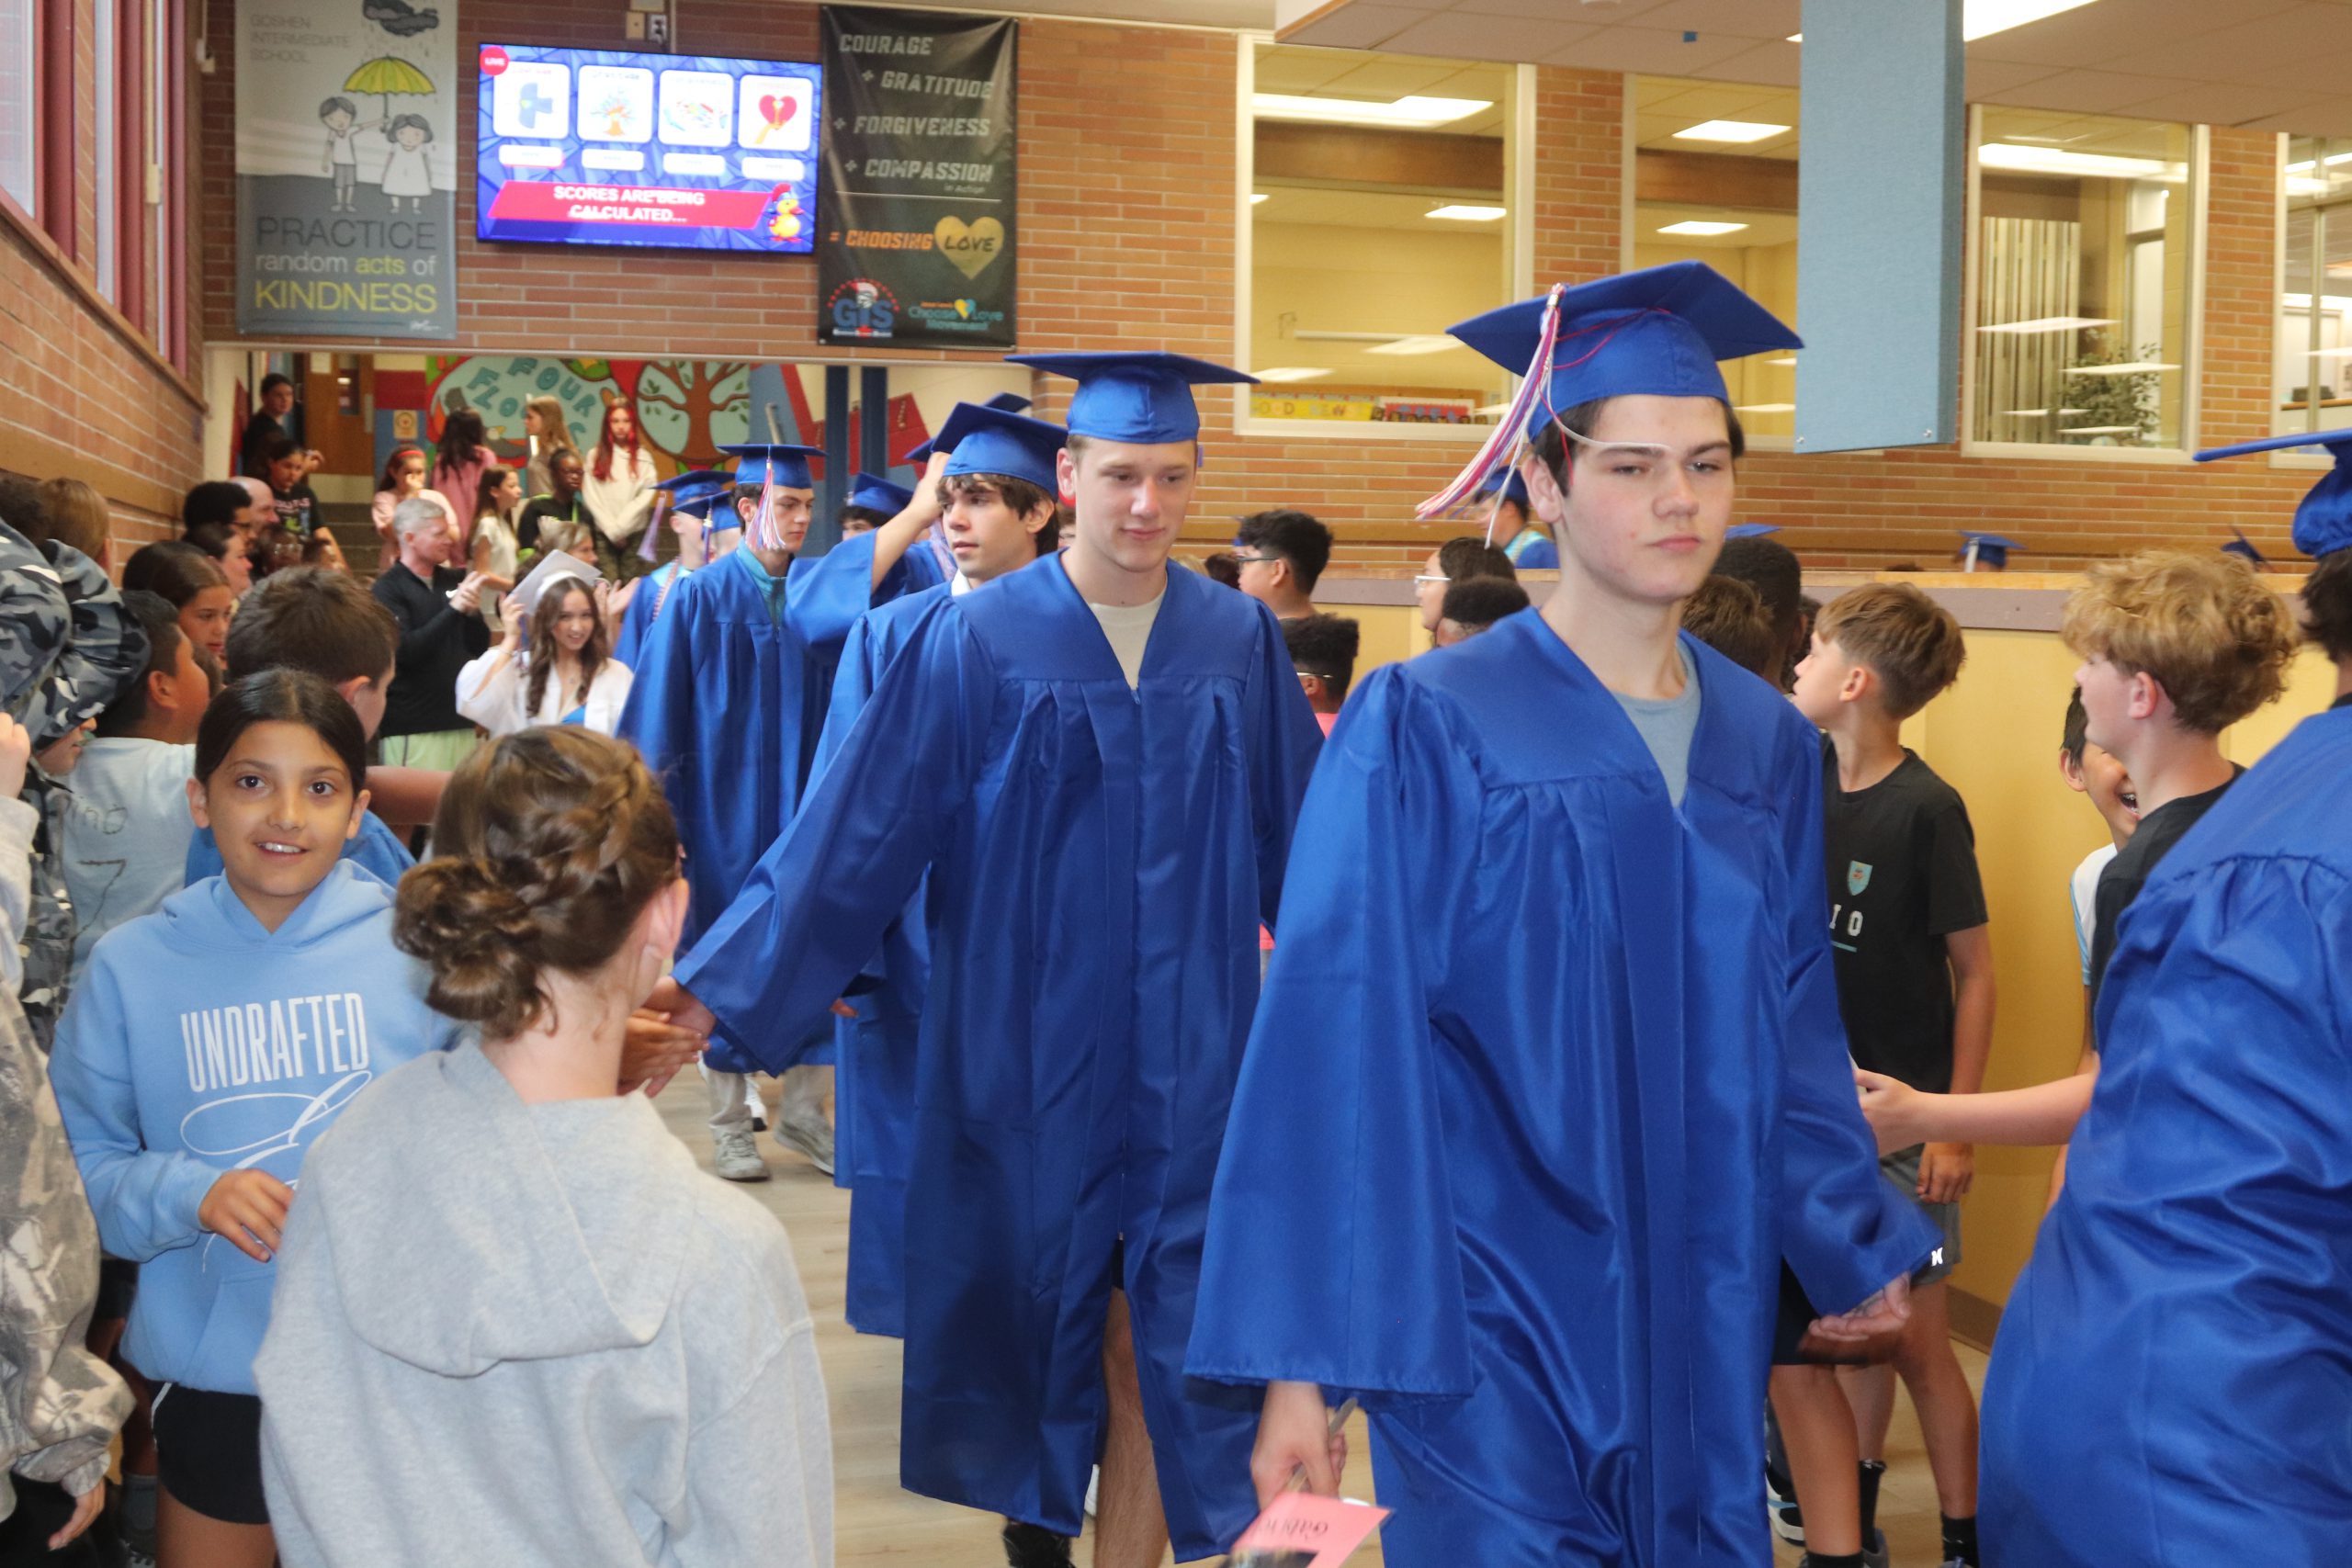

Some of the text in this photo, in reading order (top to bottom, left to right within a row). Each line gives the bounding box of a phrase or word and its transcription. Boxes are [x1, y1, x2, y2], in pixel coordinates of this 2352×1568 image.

[839, 34, 933, 55] COURAGE
[484, 57, 505, 66] LIVE
[880, 71, 995, 98] GRATITUDE
[854, 116, 990, 136] FORGIVENESS
[865, 159, 994, 182] COMPASSION
[553, 186, 706, 205] SCORES ARE BEING
[568, 204, 687, 222] CALCULATED...
[256, 217, 436, 250] PRACTICE
[845, 230, 934, 250] CHOOSING
[944, 235, 996, 252] LOVE
[254, 251, 437, 276] random acts of
[254, 279, 438, 313] KINDNESS
[507, 357, 596, 417] FOUR
[180, 992, 368, 1092] UNDRAFTED
